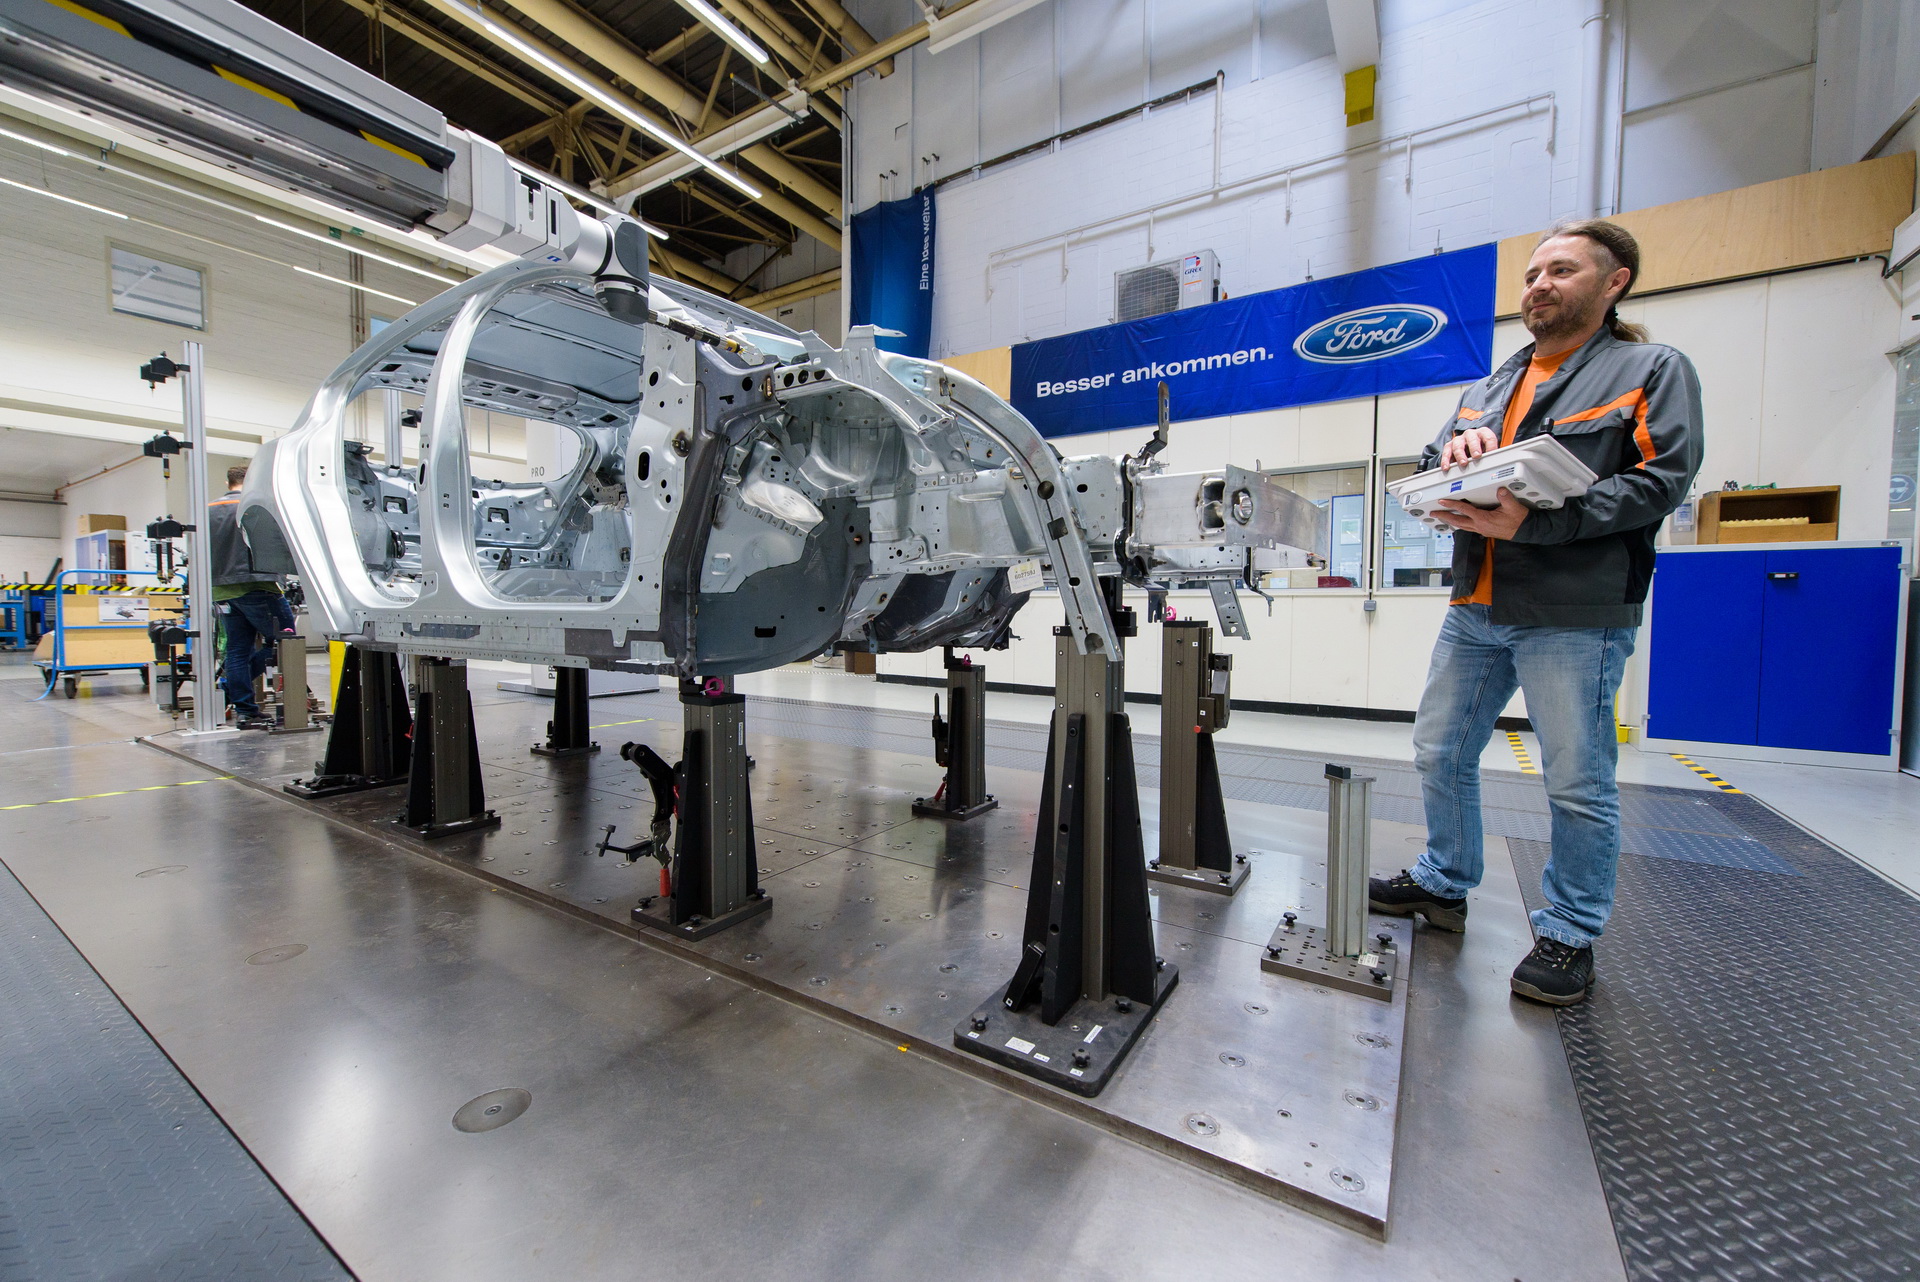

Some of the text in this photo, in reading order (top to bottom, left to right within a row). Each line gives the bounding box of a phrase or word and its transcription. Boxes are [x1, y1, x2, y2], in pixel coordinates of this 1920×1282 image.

[1325, 315, 1408, 354] Ford
[1036, 346, 1274, 398] Besser ankommen.
[531, 466, 545, 478] PRO
